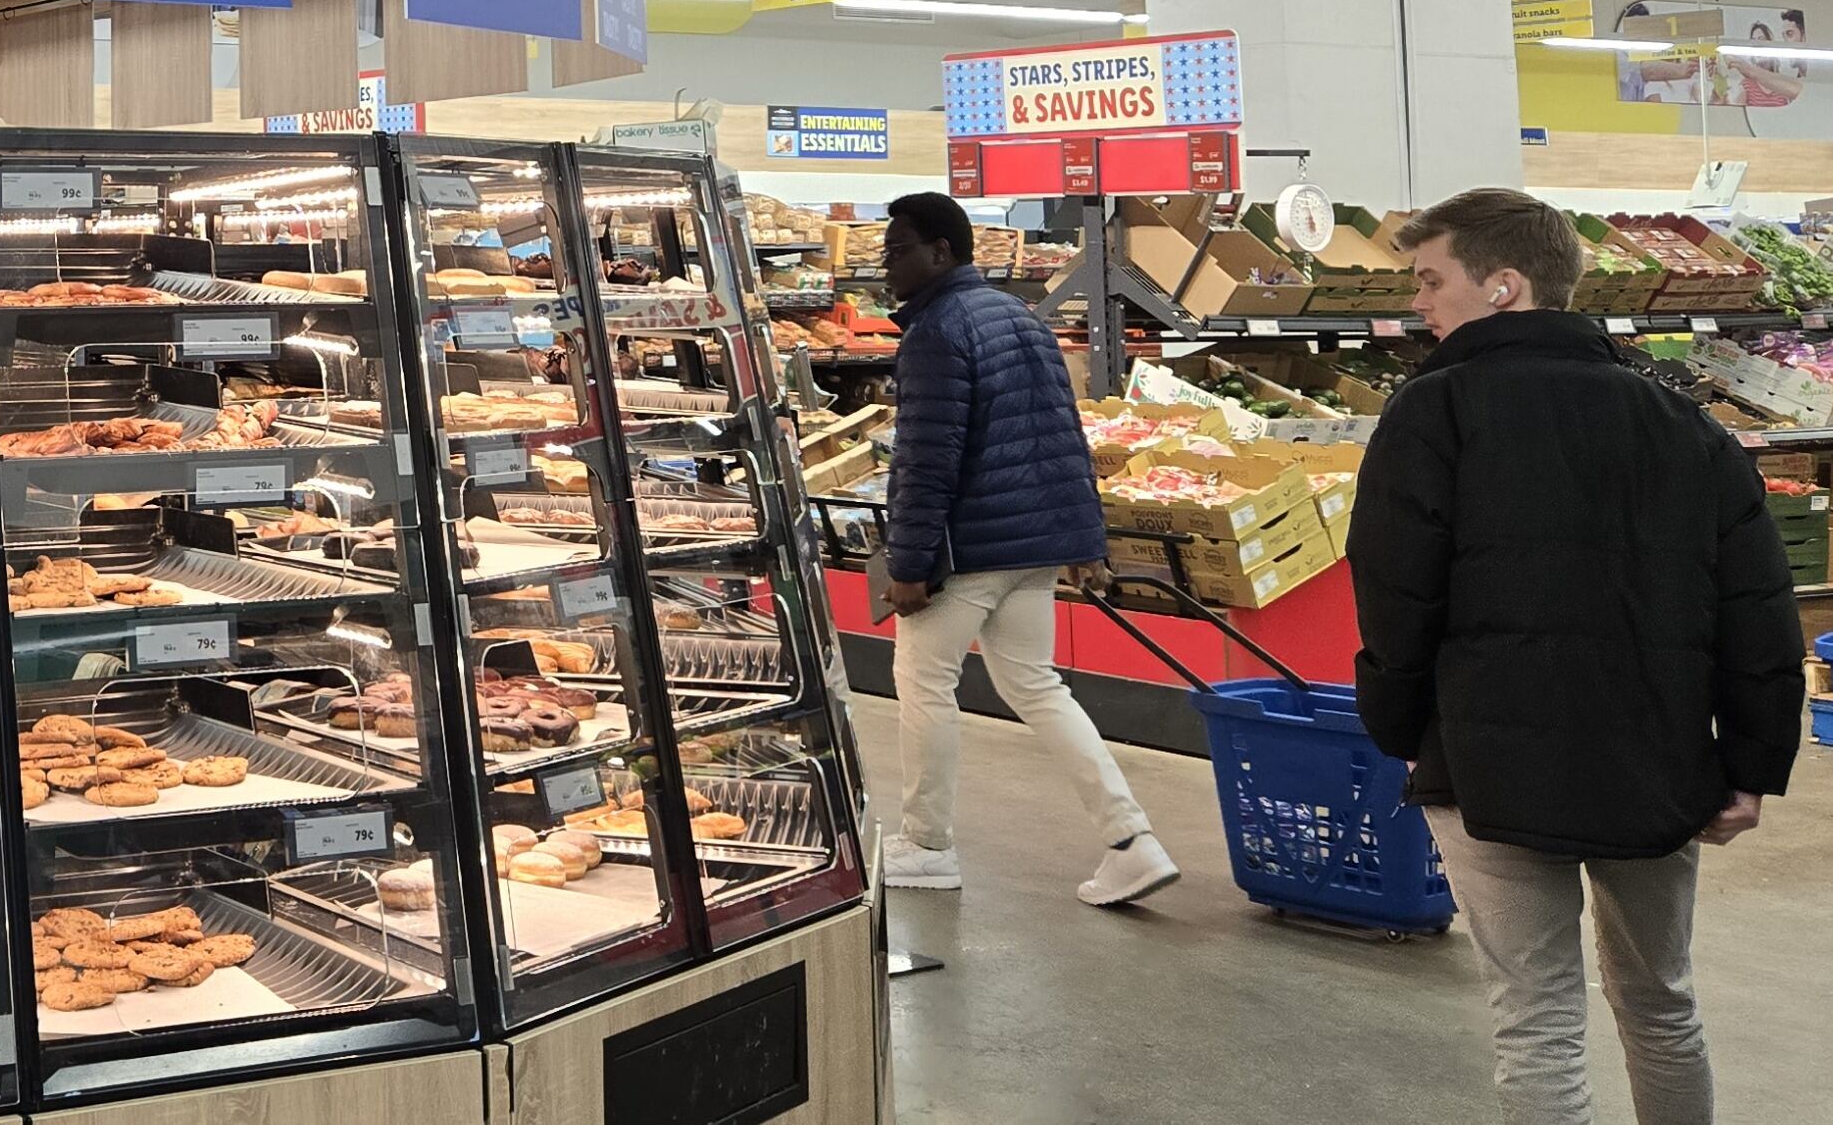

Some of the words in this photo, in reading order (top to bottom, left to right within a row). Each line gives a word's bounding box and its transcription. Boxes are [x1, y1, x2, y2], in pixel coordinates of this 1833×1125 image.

[1529, 7, 1560, 18] snacks
[1543, 27, 1563, 38] bars
[1666, 17, 1678, 36] 1
[1010, 63, 1068, 87] STARS,
[1072, 56, 1156, 82] STRIPES,
[1012, 94, 1030, 124] &
[1034, 85, 1156, 123] SAVINGS
[302, 112, 310, 134] &
[313, 107, 373, 132] SAVINGS
[800, 114, 886, 132] ENTERTAINING
[616, 127, 654, 139] bakery
[658, 124, 689, 136] tissue
[801, 133, 887, 153] ESSENTIALS
[62, 188, 82, 199] 99¢
[1135, 519, 1175, 531] DOUX
[197, 638, 216, 650] 79¢
[355, 830, 374, 841] 79¢
